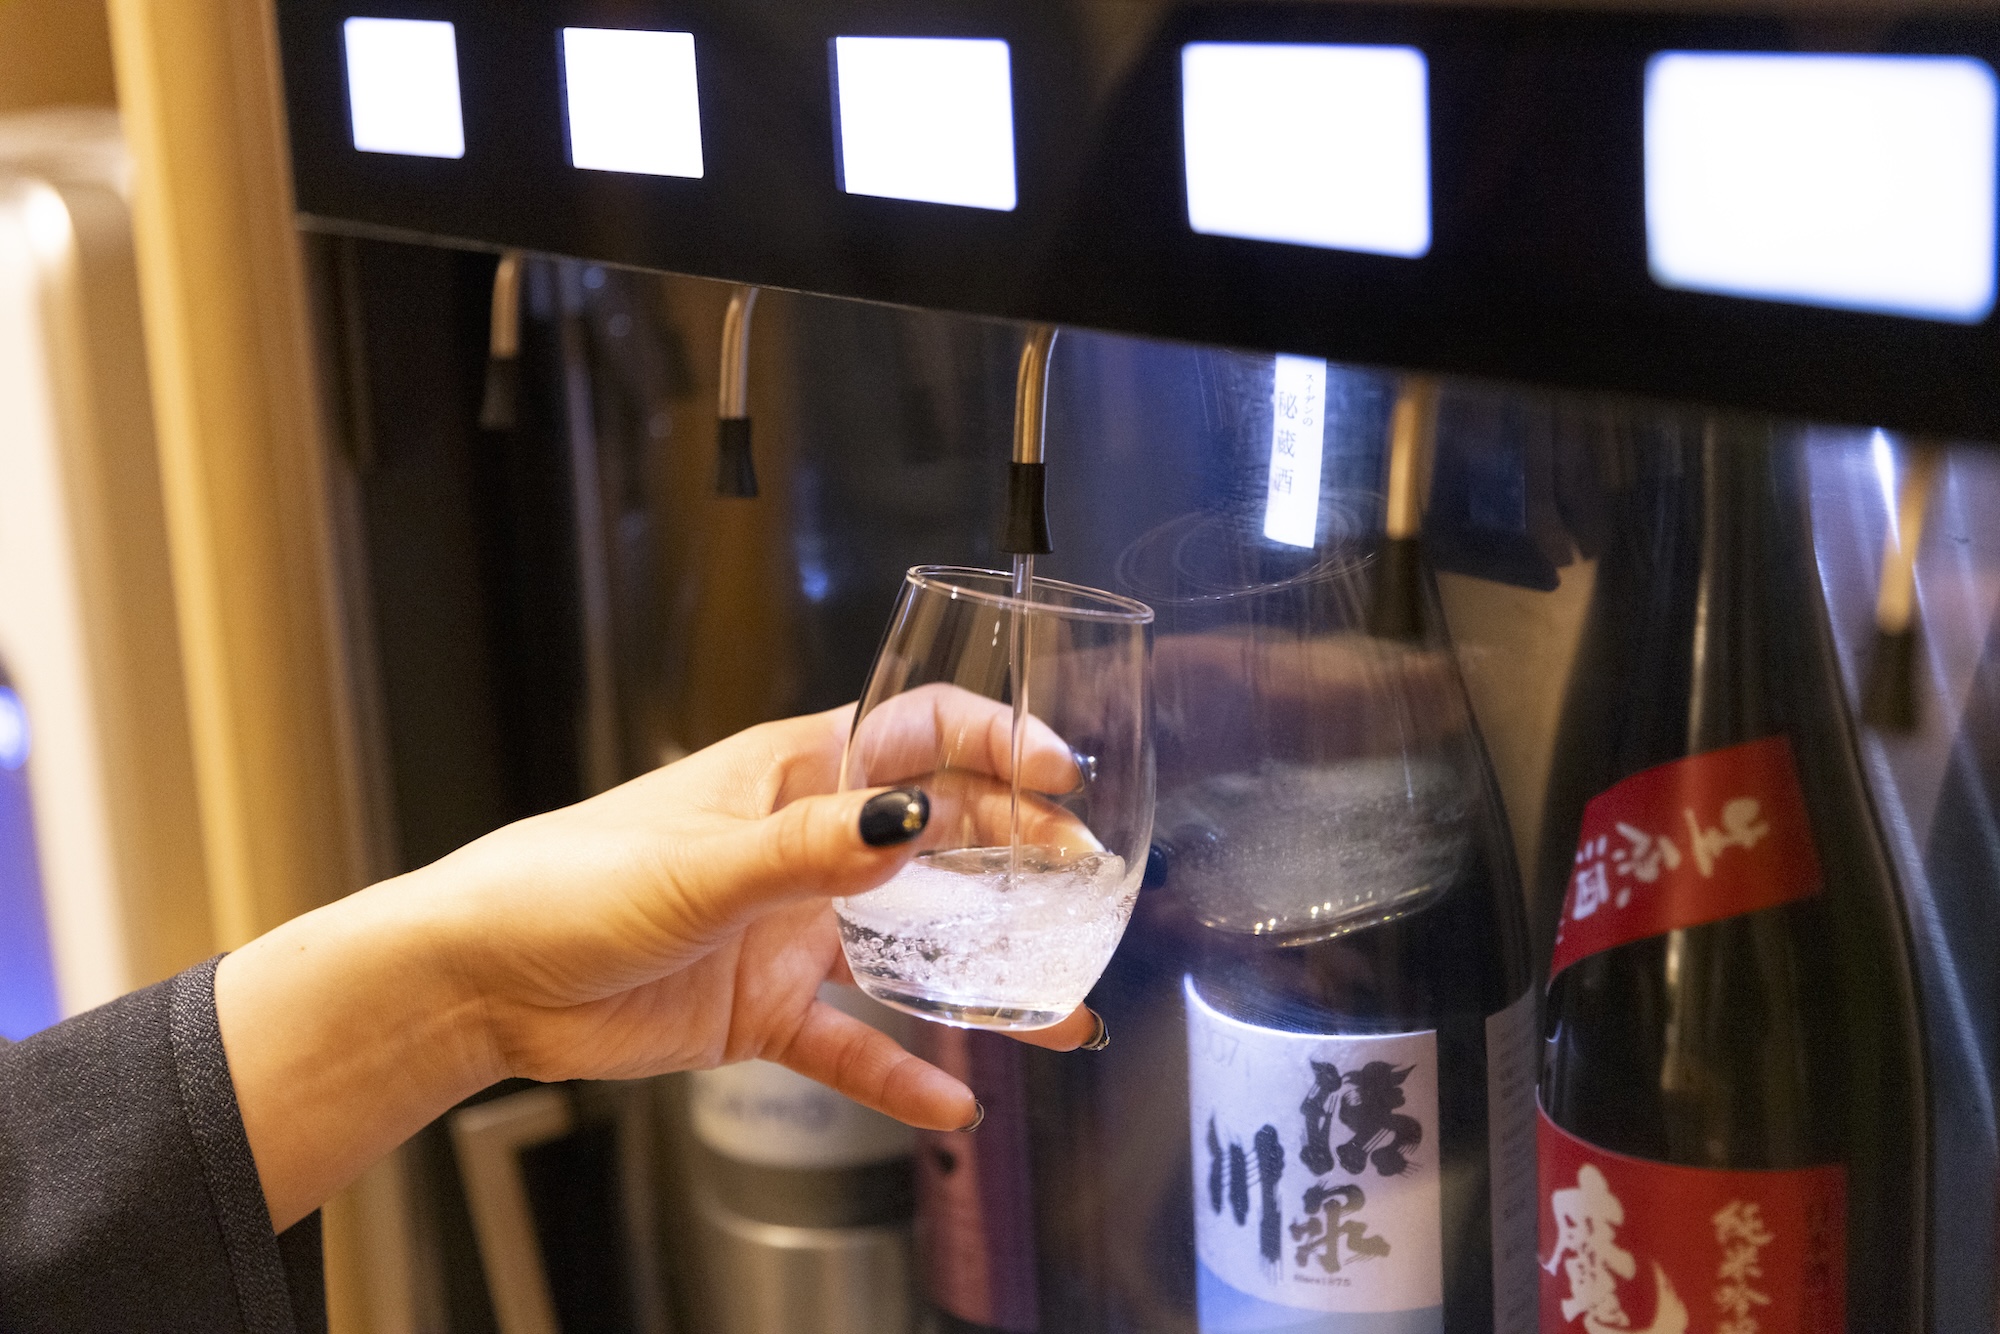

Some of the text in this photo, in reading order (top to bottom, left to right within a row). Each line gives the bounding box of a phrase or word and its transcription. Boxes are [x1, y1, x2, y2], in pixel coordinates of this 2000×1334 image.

[1302, 373, 1316, 427] スイデンの
[1274, 391, 1298, 495] 秘蔵酒
